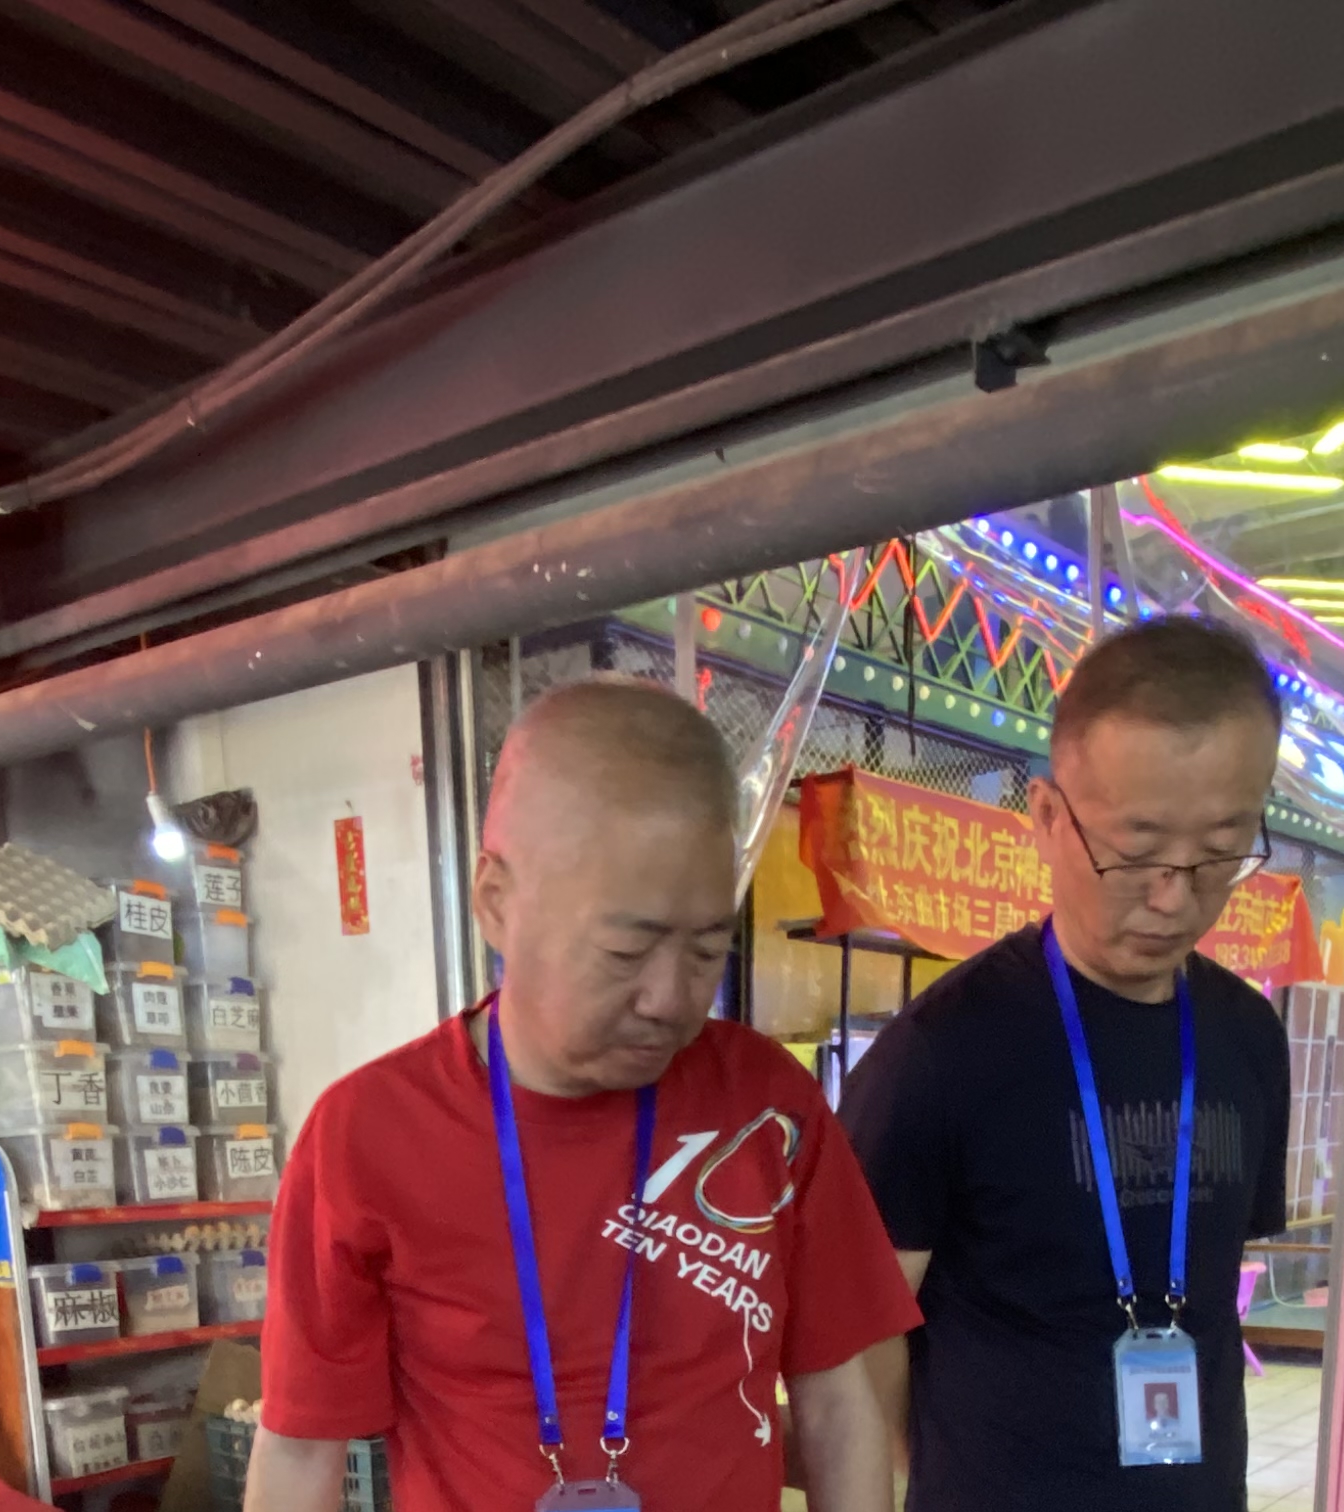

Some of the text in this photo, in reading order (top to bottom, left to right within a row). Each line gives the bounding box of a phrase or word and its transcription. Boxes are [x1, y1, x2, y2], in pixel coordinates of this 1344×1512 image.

[204, 872, 241, 903] 莲子
[125, 899, 170, 934] 桂皮
[41, 1070, 105, 1106] 丁香
[230, 1147, 272, 1174] 陈皮
[617, 1203, 772, 1281] QIAODAN
[601, 1218, 774, 1334] TEN YEARS
[53, 1291, 119, 1327] 麻椒
